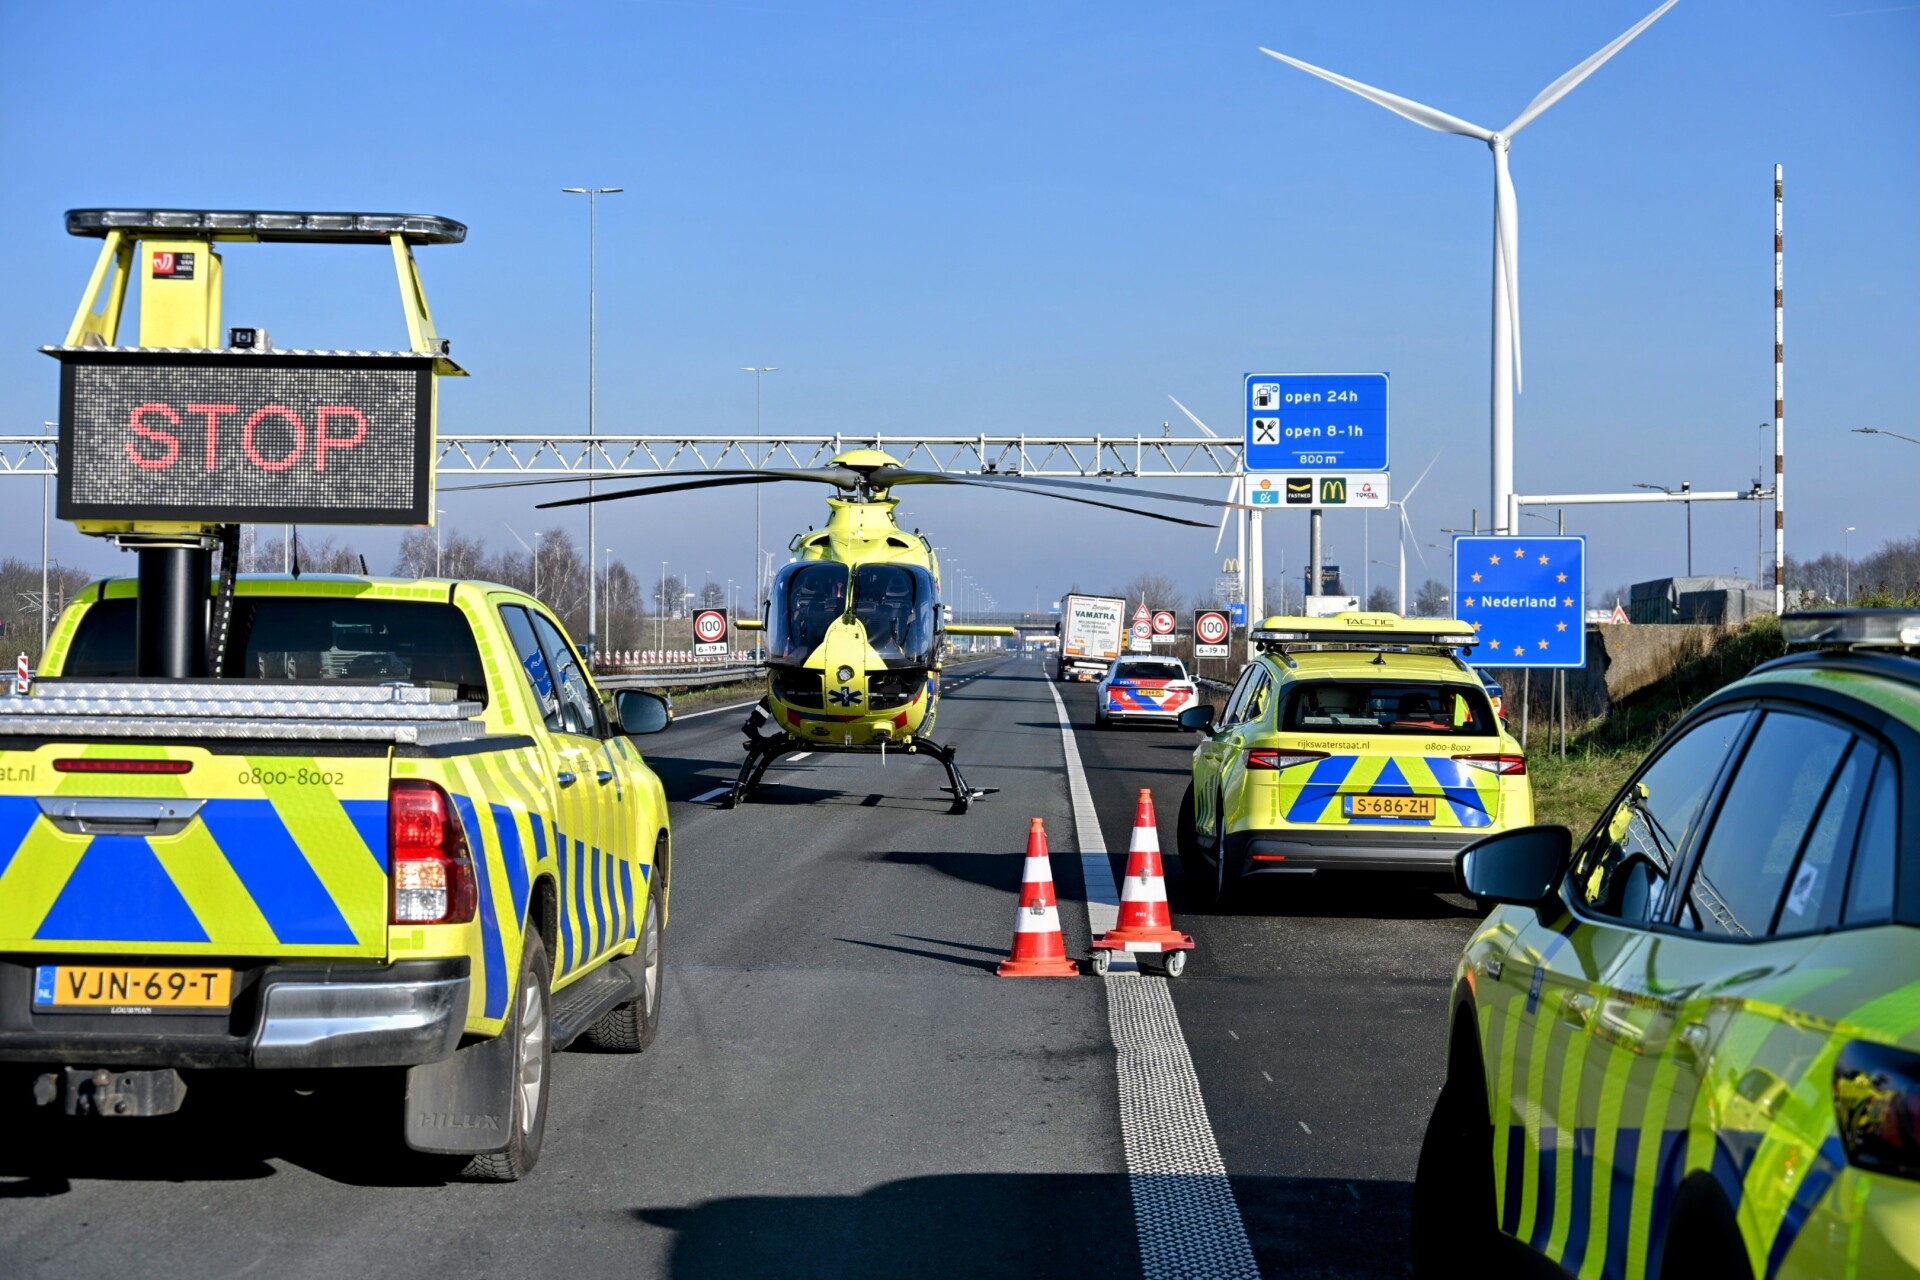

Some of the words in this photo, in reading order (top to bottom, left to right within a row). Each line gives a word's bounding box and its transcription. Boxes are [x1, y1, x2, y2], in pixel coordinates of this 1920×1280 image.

[1285, 392, 1322, 404] open
[1327, 390, 1358, 402] 24h
[125, 403, 368, 472] STOP
[1285, 427, 1322, 439] open
[1327, 425, 1363, 437] 8-1h
[1299, 455, 1323, 464] 800
[1325, 456, 1337, 464] m
[1481, 595, 1557, 608] Nederland
[1075, 610, 1116, 620] VAMATRA
[701, 620, 721, 632] 100
[1203, 622, 1223, 633] 100
[1343, 618, 1395, 626] TACTIC
[1136, 625, 1149, 634] 90
[698, 645, 717, 653] 6-19
[1297, 740, 1370, 750] rijkswaterstaat.nl
[1425, 743, 1471, 752] 0800-8002
[238, 767, 344, 786] 0800-8002
[1357, 799, 1429, 813] S-686-ZH
[69, 972, 218, 1000] VJN-69-T
[38, 989, 53, 998] NL
[418, 1112, 502, 1130] HILUX
